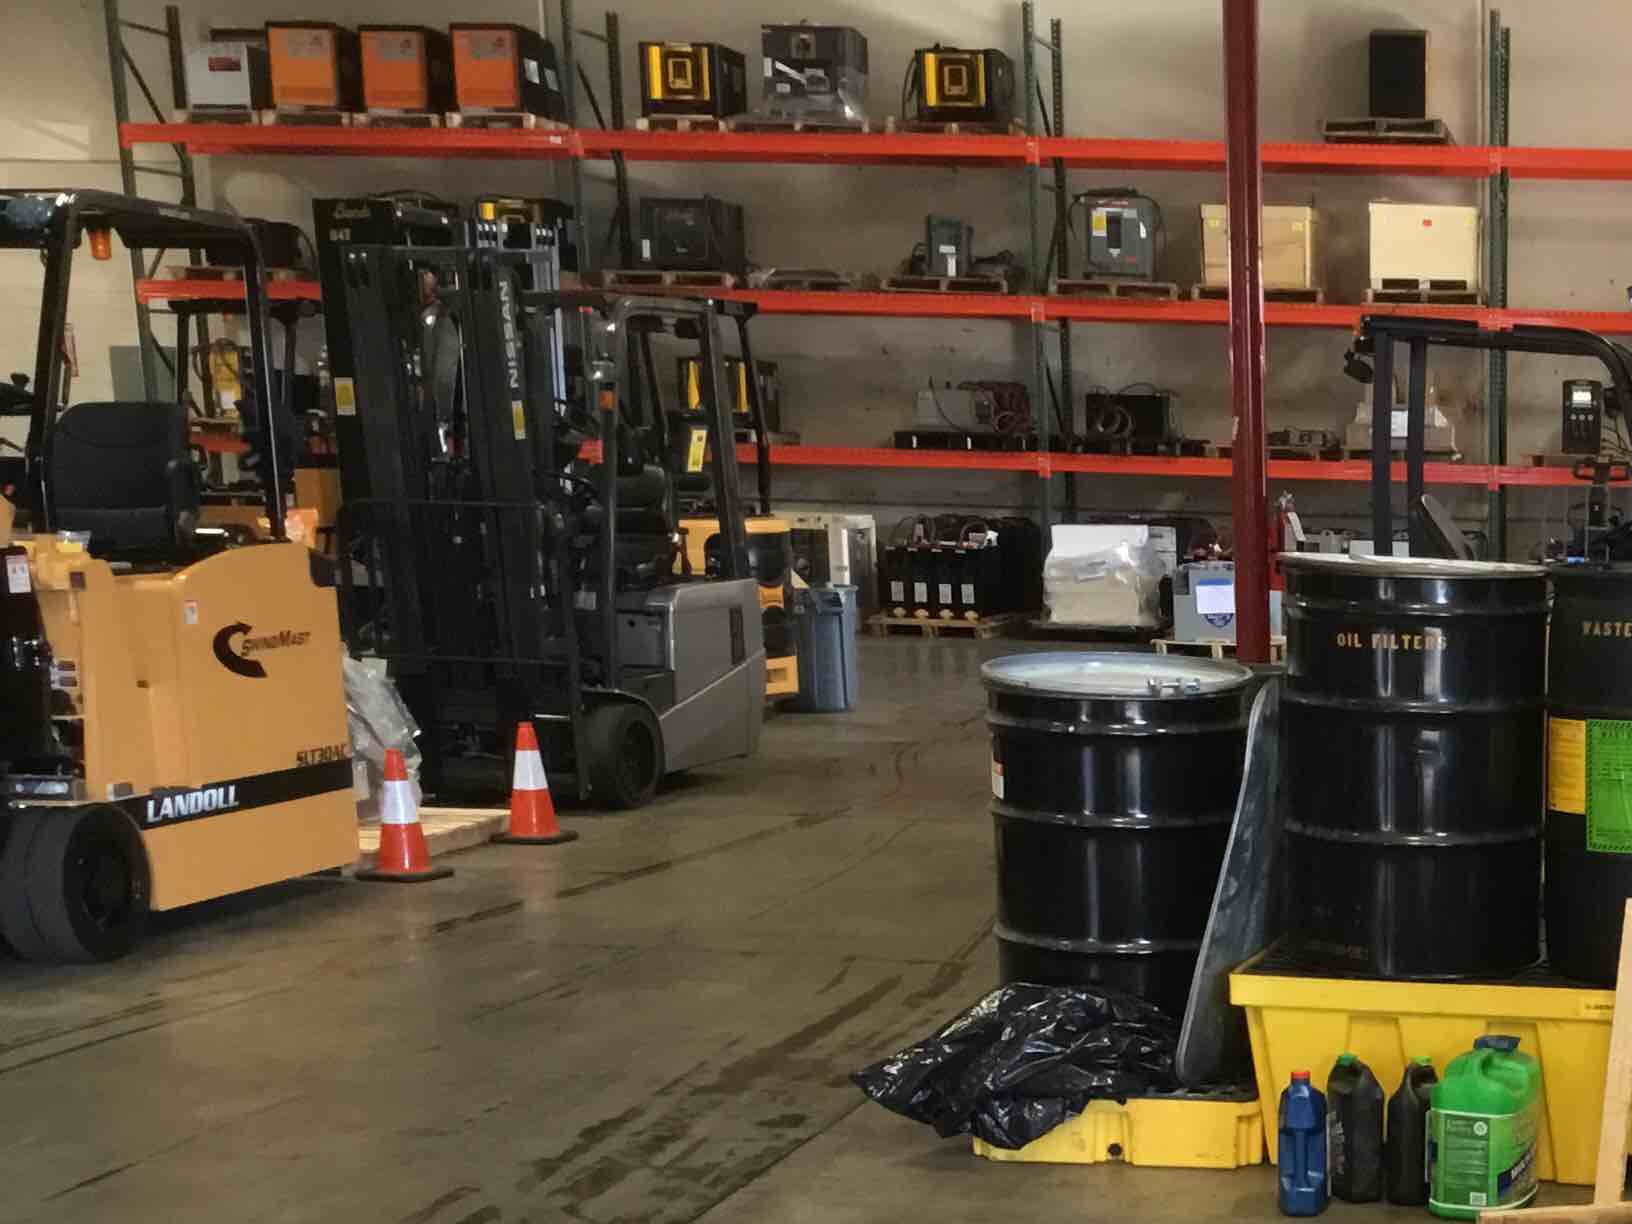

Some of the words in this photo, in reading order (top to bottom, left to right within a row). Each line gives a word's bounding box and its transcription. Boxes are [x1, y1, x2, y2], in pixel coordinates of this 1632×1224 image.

[499, 280, 520, 388] NISSAN
[1336, 632, 1362, 648] OIL
[1371, 632, 1447, 650] FILTERS
[1582, 620, 1632, 637] WASTE
[146, 784, 240, 824] LANDOLL
